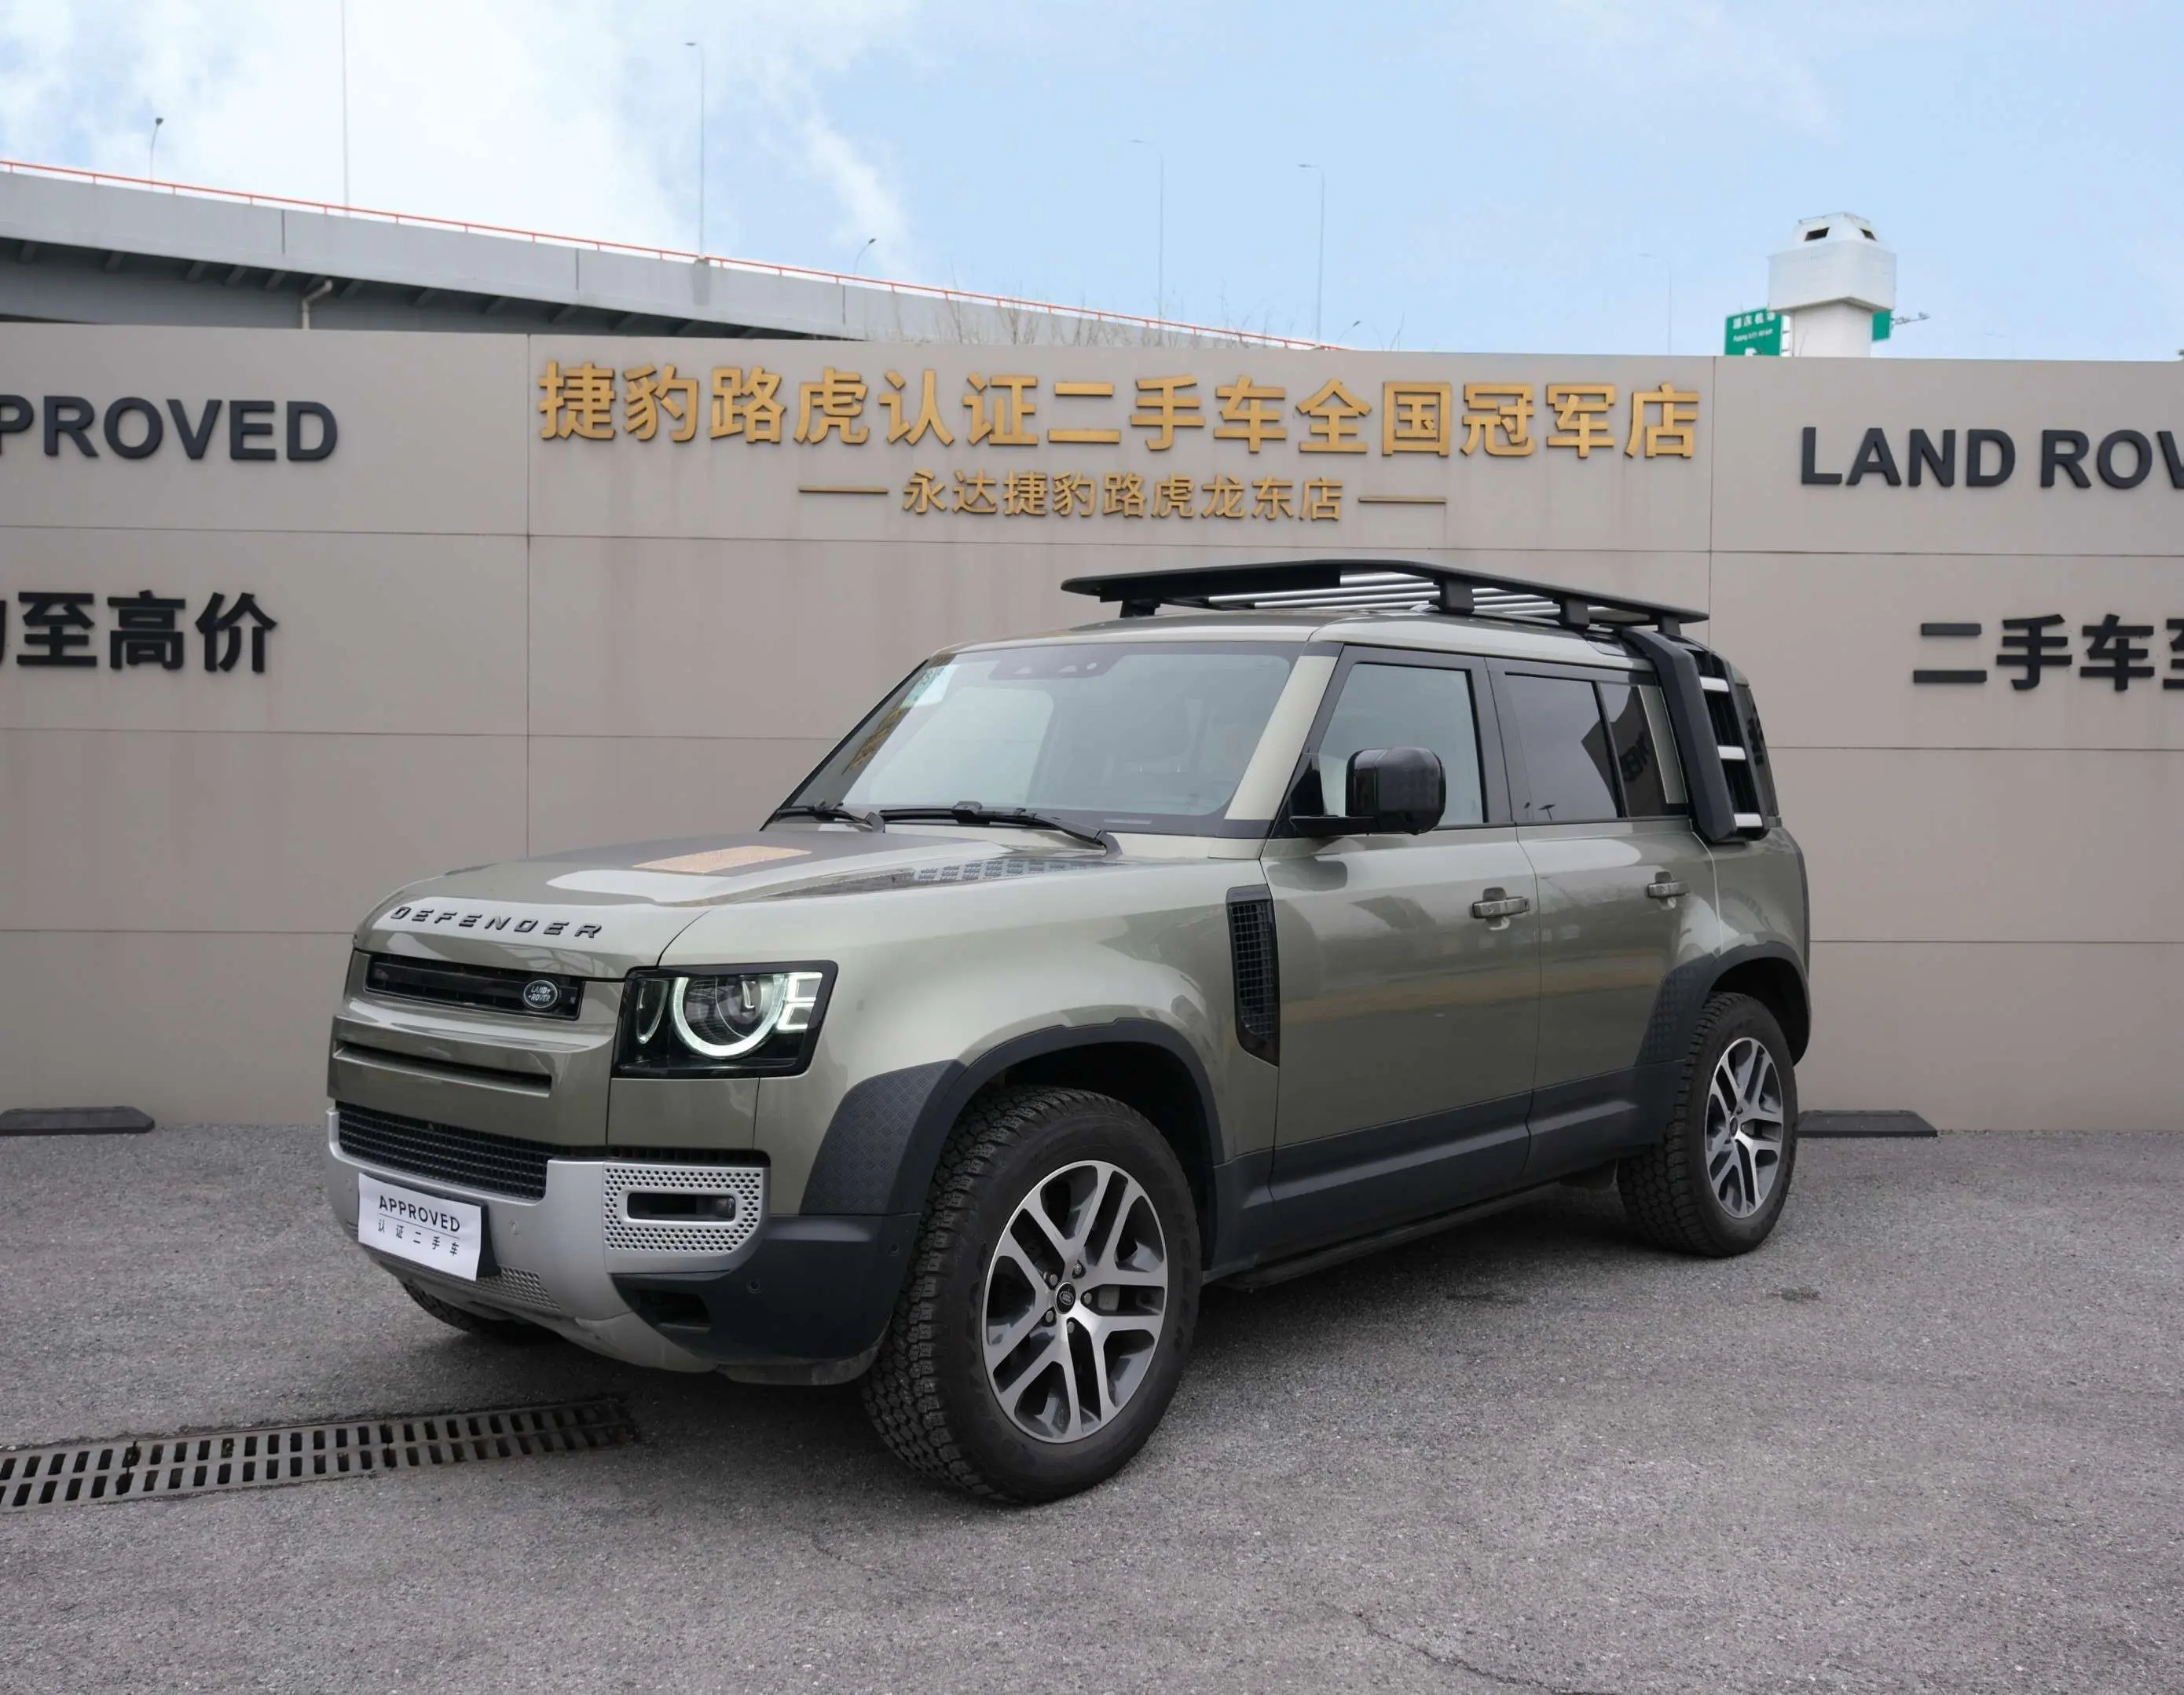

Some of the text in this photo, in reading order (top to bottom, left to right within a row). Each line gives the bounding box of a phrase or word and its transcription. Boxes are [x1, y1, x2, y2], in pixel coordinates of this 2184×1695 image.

[538, 360, 1702, 460] 捷豹路虎认证二手车全国冠军店
[1801, 426, 2017, 489] LAND
[903, 469, 1343, 522] 永达捷豹路虎龙东店
[0, 589, 278, 675] 至高价
[1912, 613, 2184, 693] 二手车
[390, 906, 602, 938] DEFENDER
[378, 1219, 460, 1257] 认证二手车
[379, 1195, 460, 1232] APPROVED
